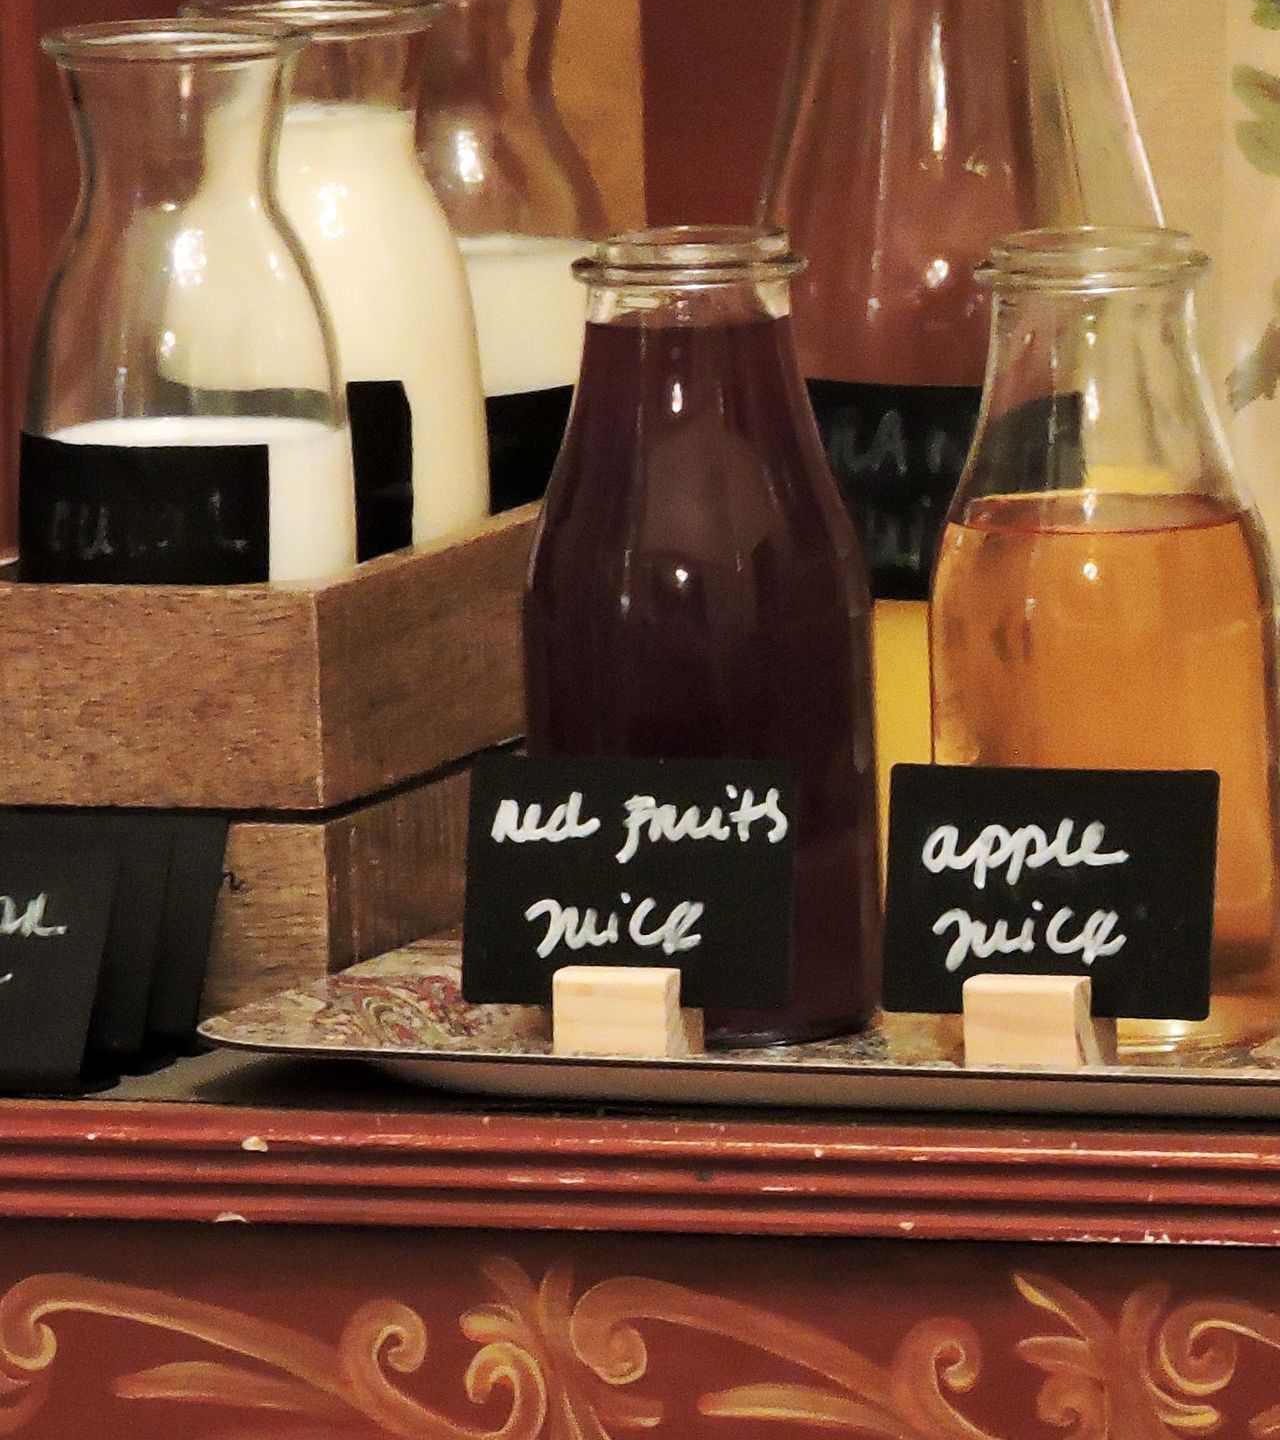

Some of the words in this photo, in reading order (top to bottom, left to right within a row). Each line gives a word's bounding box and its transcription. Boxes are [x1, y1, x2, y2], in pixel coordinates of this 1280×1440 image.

[490, 791, 600, 843] red
[615, 784, 789, 864] fruits
[921, 817, 1130, 890] apple
[524, 892, 704, 959] juice
[932, 899, 1128, 973] juice
